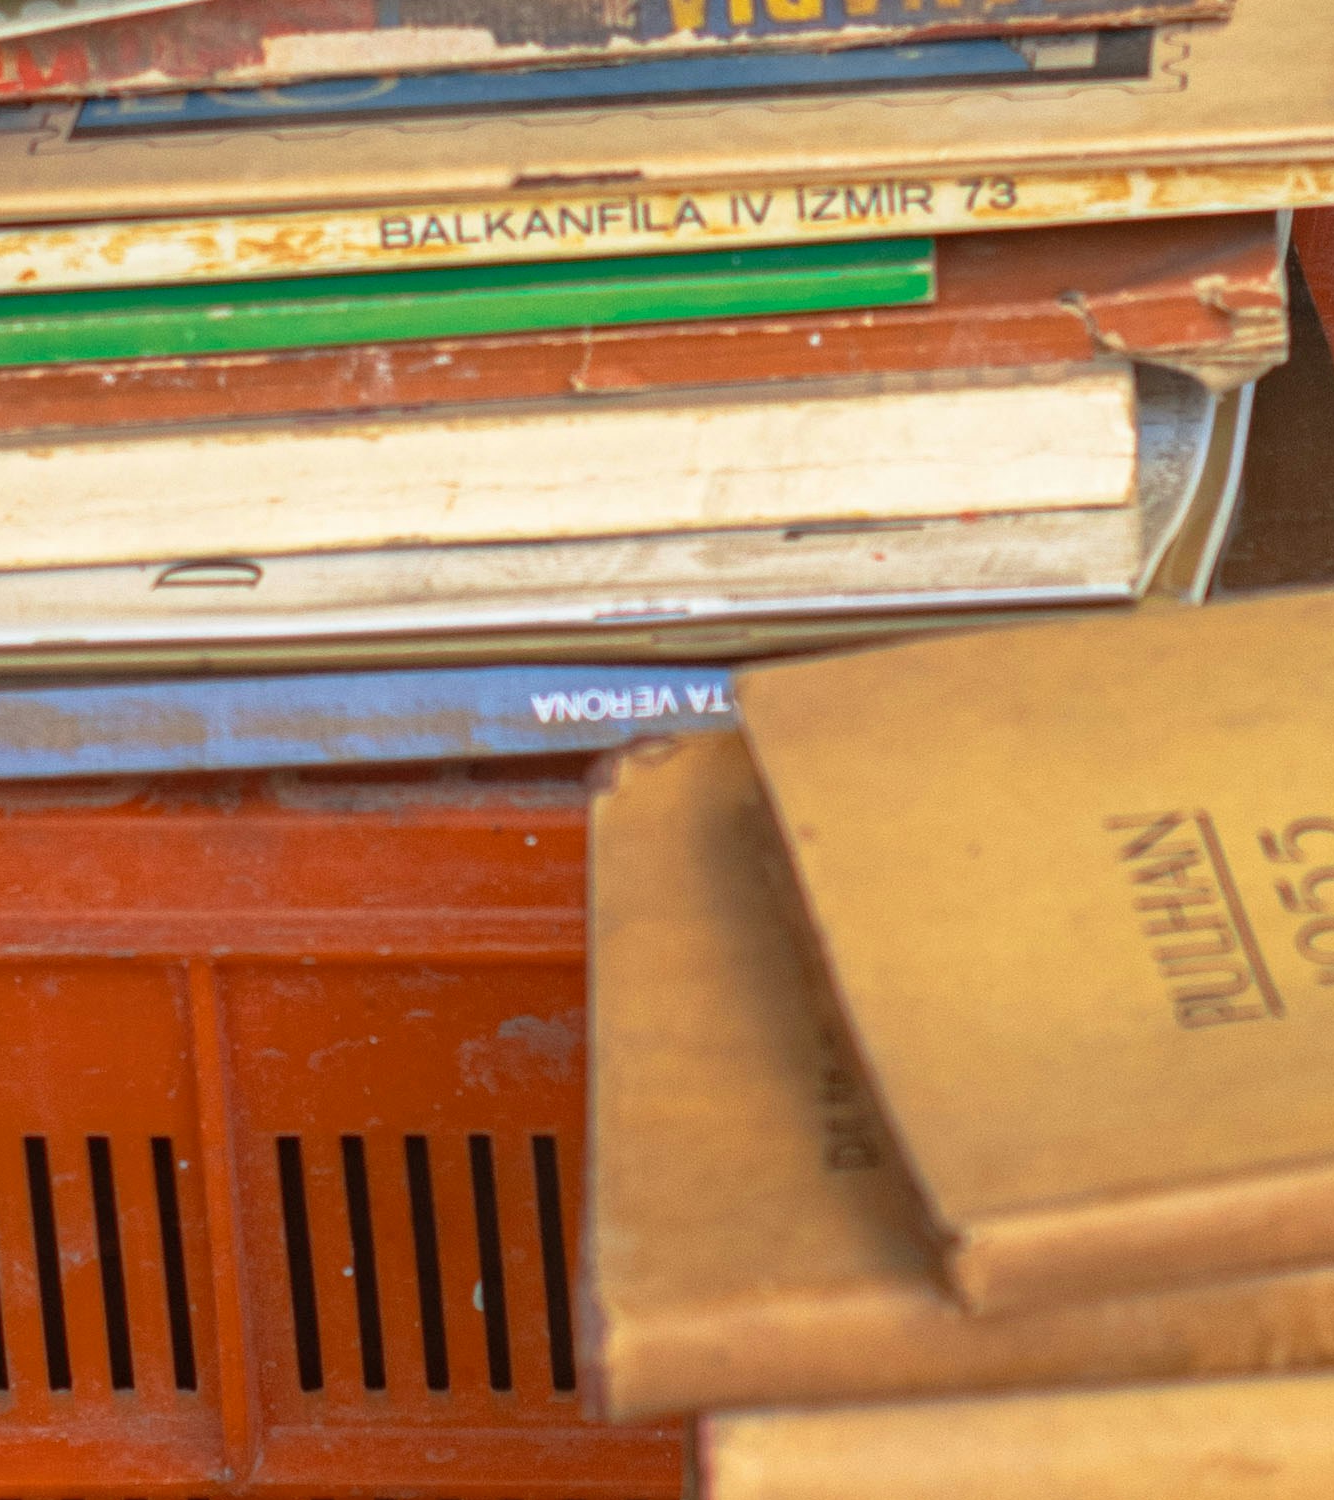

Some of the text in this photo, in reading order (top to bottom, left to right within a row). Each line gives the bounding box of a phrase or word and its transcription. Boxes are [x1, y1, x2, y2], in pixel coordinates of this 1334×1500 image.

[729, 186, 774, 227] IV
[959, 178, 1019, 214] 73
[531, 684, 673, 724] VERONA
[1104, 808, 1268, 1031] PULHAN
